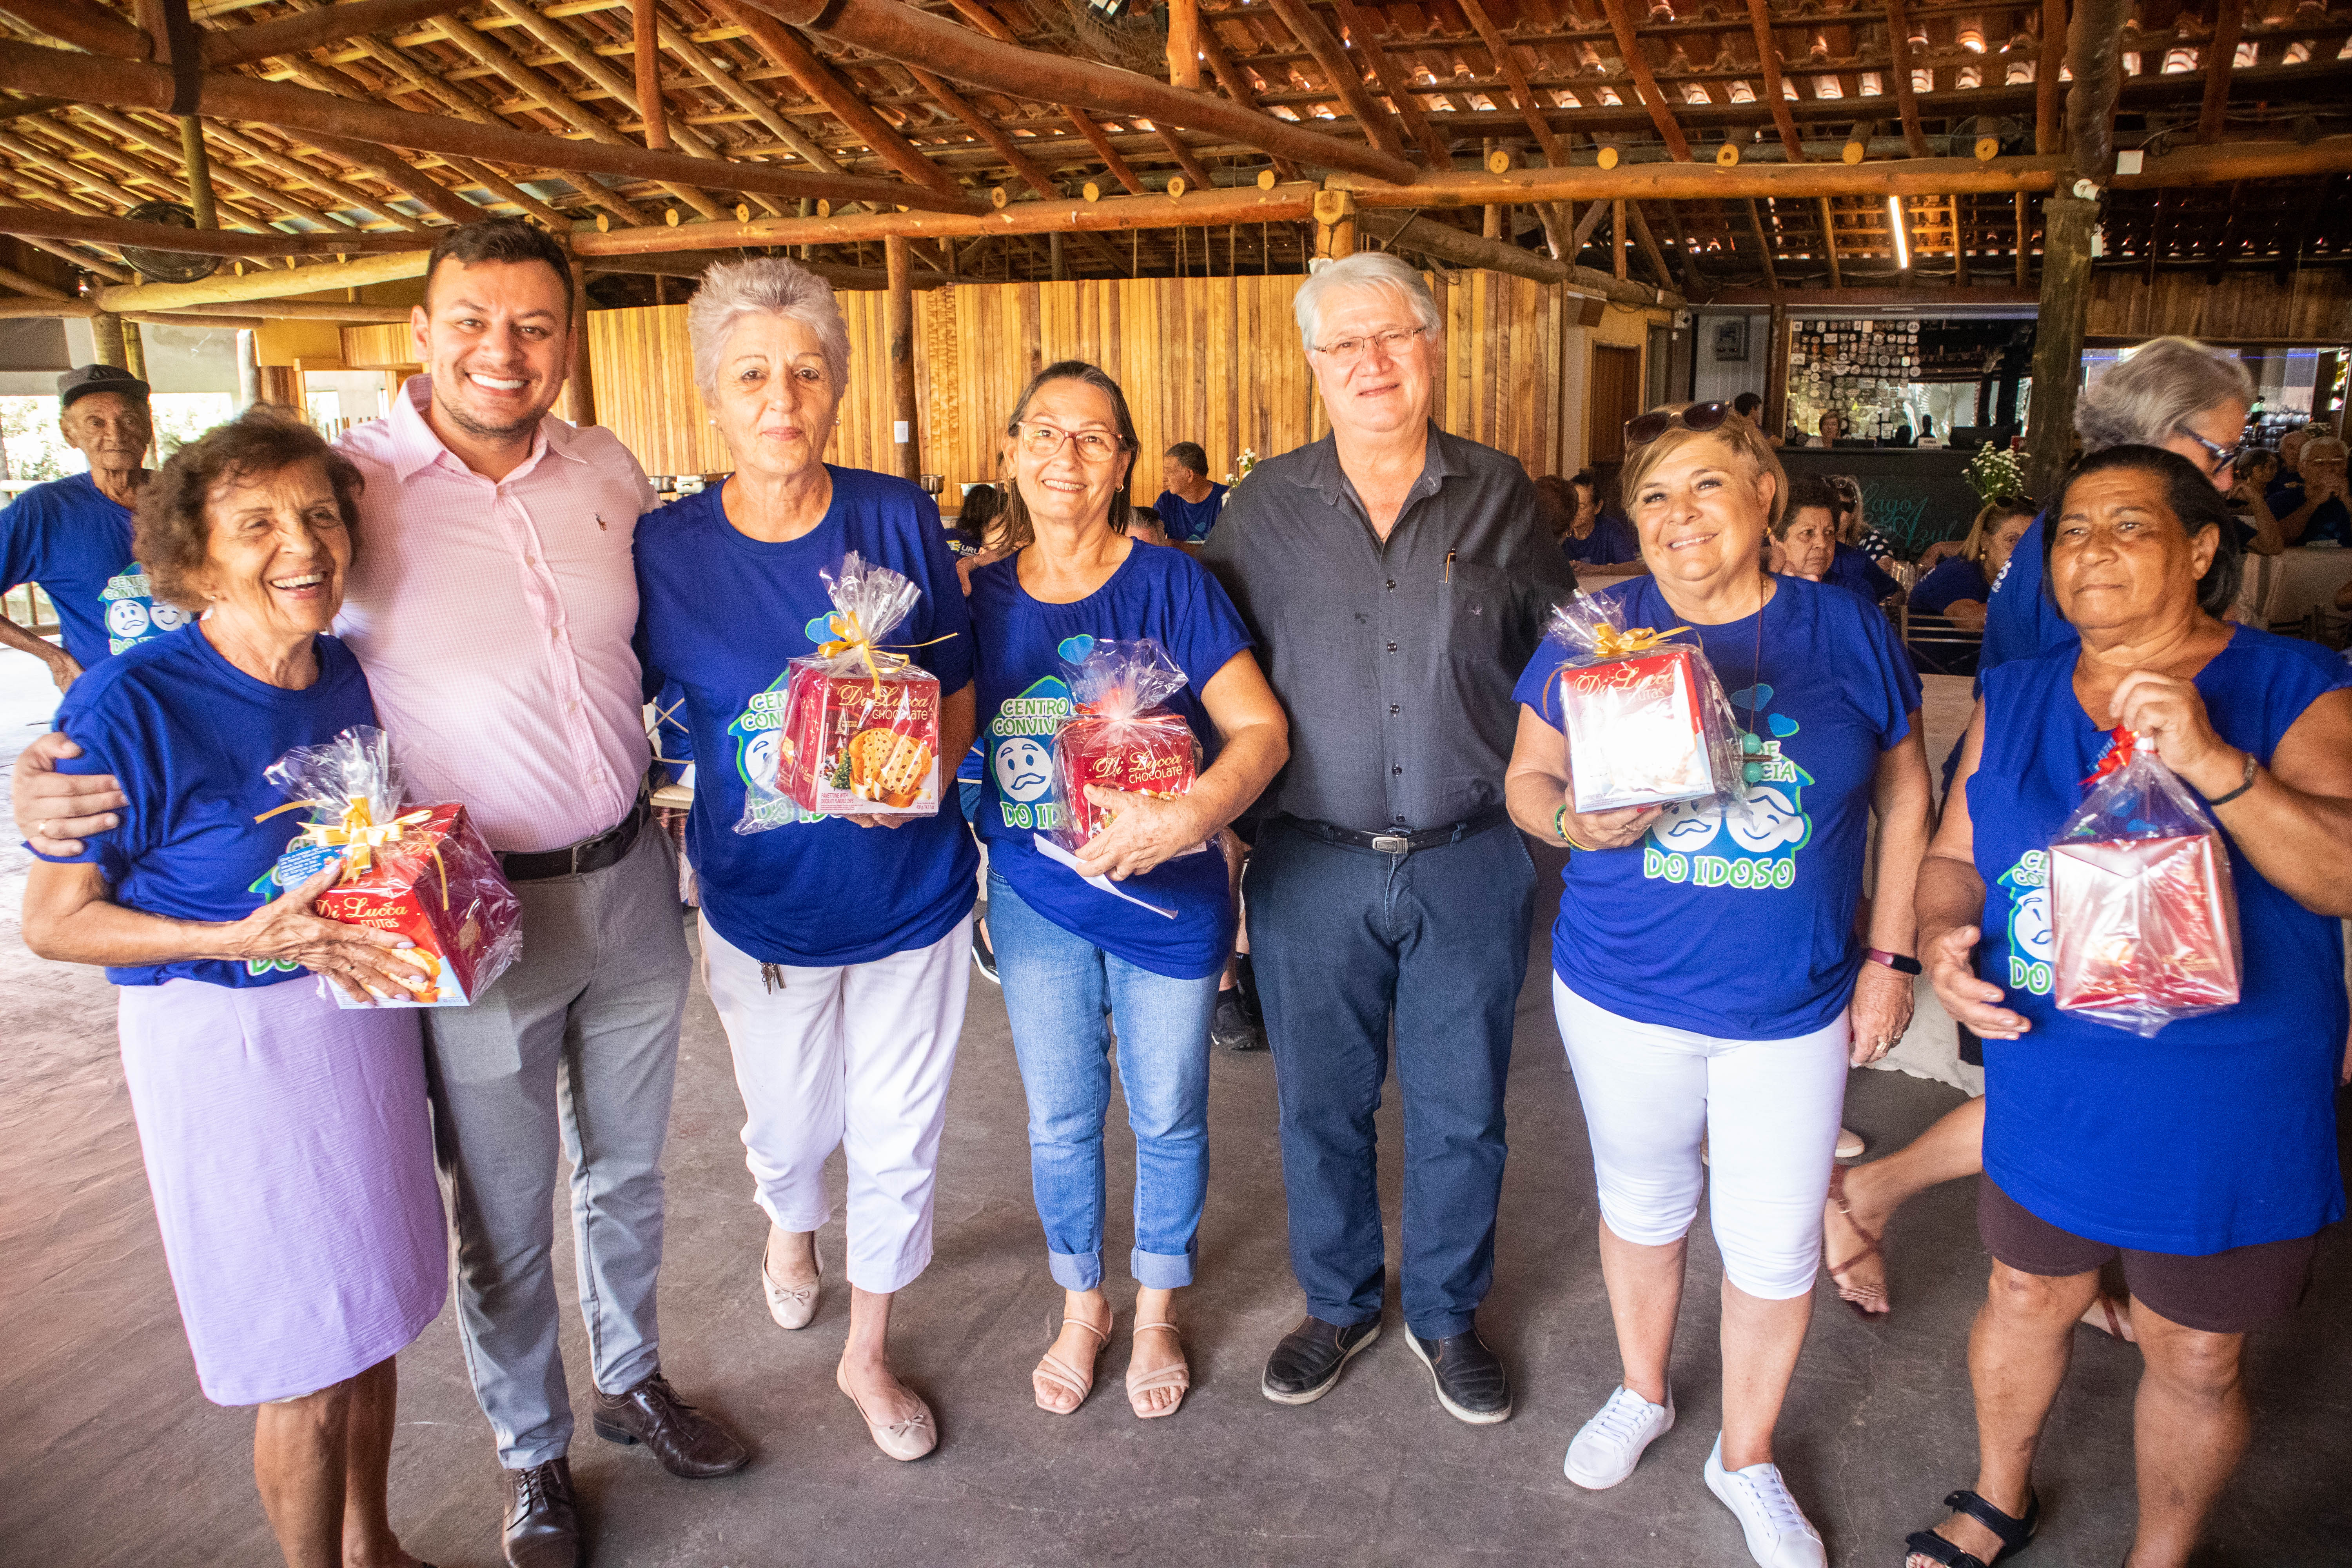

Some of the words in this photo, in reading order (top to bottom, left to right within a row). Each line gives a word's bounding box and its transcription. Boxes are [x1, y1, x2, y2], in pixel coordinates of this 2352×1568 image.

[108, 574, 151, 588] CENTR
[837, 684, 869, 706] Di
[873, 685, 929, 707] Luca
[1001, 697, 1069, 717] CENTRO
[992, 717, 1058, 737] CONVIV
[1093, 757, 1123, 778] Di
[1128, 751, 1182, 772] Lucca
[1000, 802, 1033, 829] DO
[1644, 848, 1688, 883] DO
[1693, 856, 1796, 889] IDOSO
[316, 899, 340, 918] Di
[343, 897, 408, 918] Lucca
[2009, 955, 2053, 995] DO
